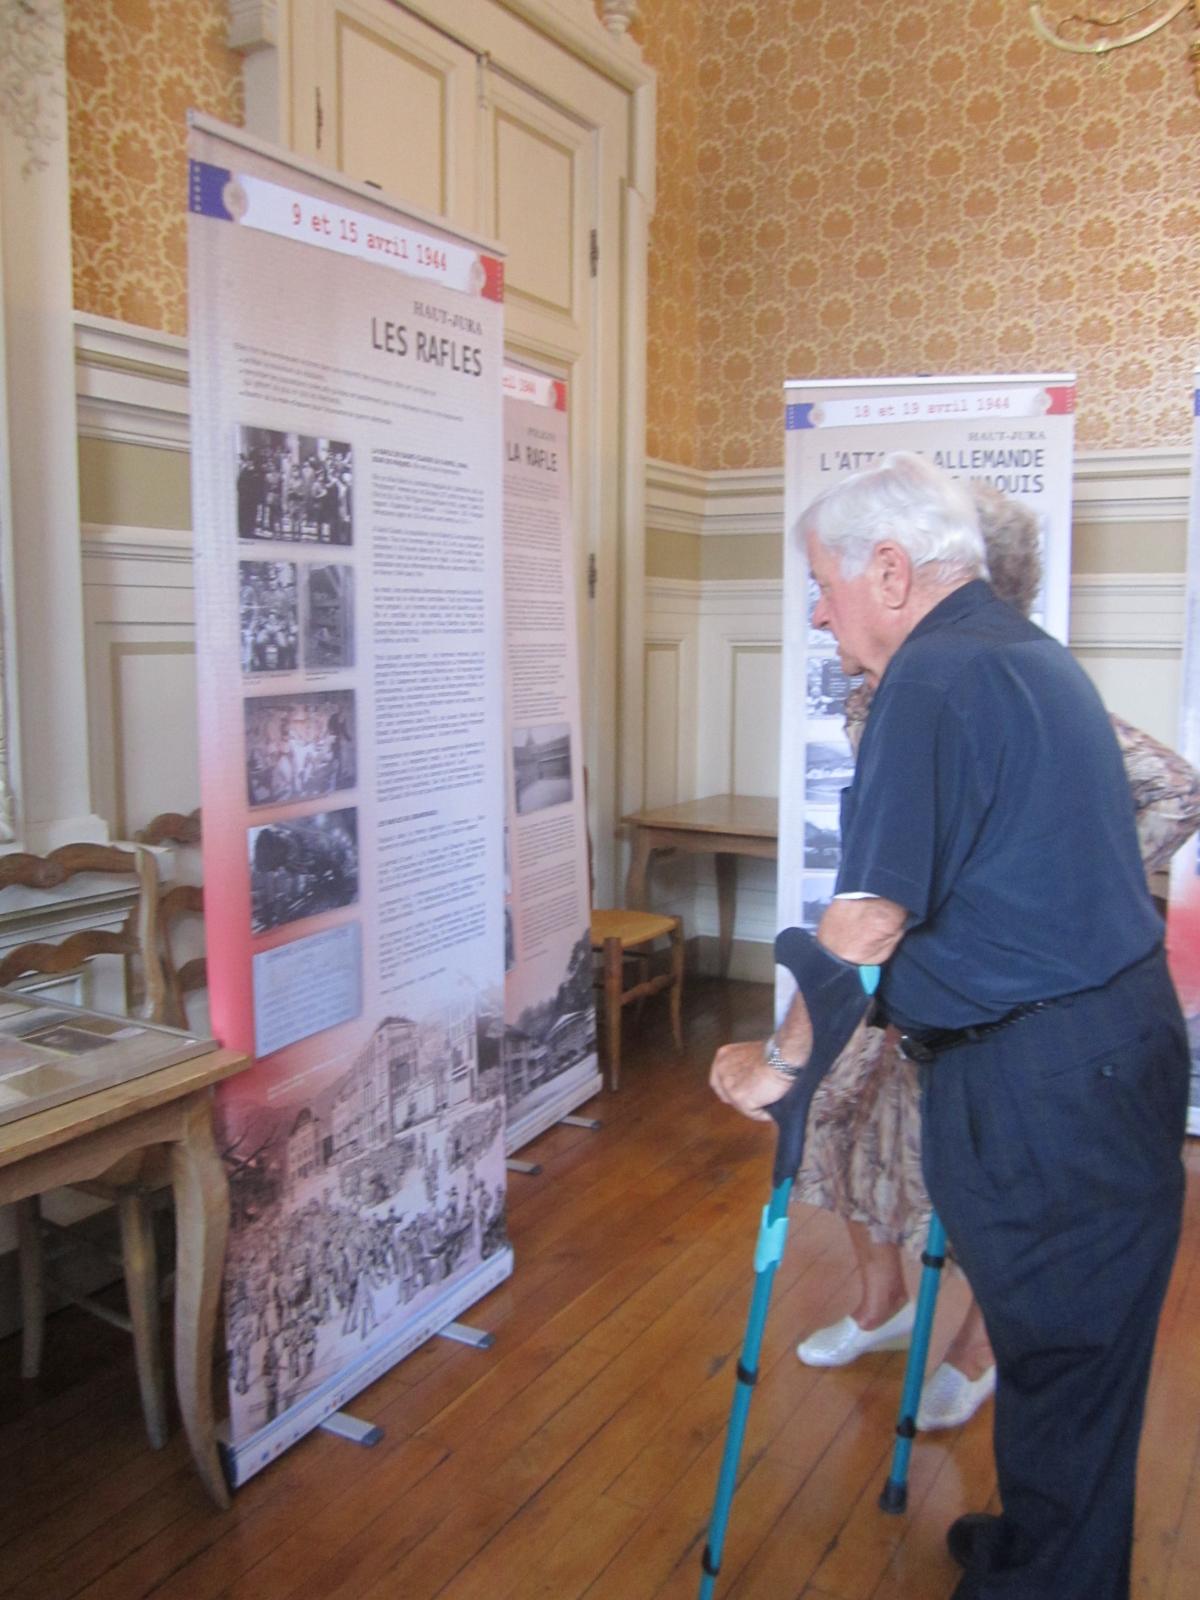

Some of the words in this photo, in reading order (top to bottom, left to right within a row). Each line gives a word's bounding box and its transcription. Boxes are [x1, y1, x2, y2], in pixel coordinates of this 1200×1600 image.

[292, 203, 302, 225] 9
[311, 213, 331, 235] et
[339, 219, 358, 243] 15
[367, 232, 409, 259] avril
[416, 243, 447, 271] 1944
[413, 301, 482, 335] HAUT-JURA
[372, 318, 408, 356] LES
[416, 331, 482, 377] RAFLES
[854, 404, 871, 418] 18
[879, 405, 895, 416] et
[903, 402, 920, 415] 19
[927, 399, 968, 414] avril
[977, 396, 1010, 411] 1944
[506, 441, 521, 463] LA
[526, 445, 558, 472] RAFLE
[934, 449, 1045, 469] ALLEMANDE
